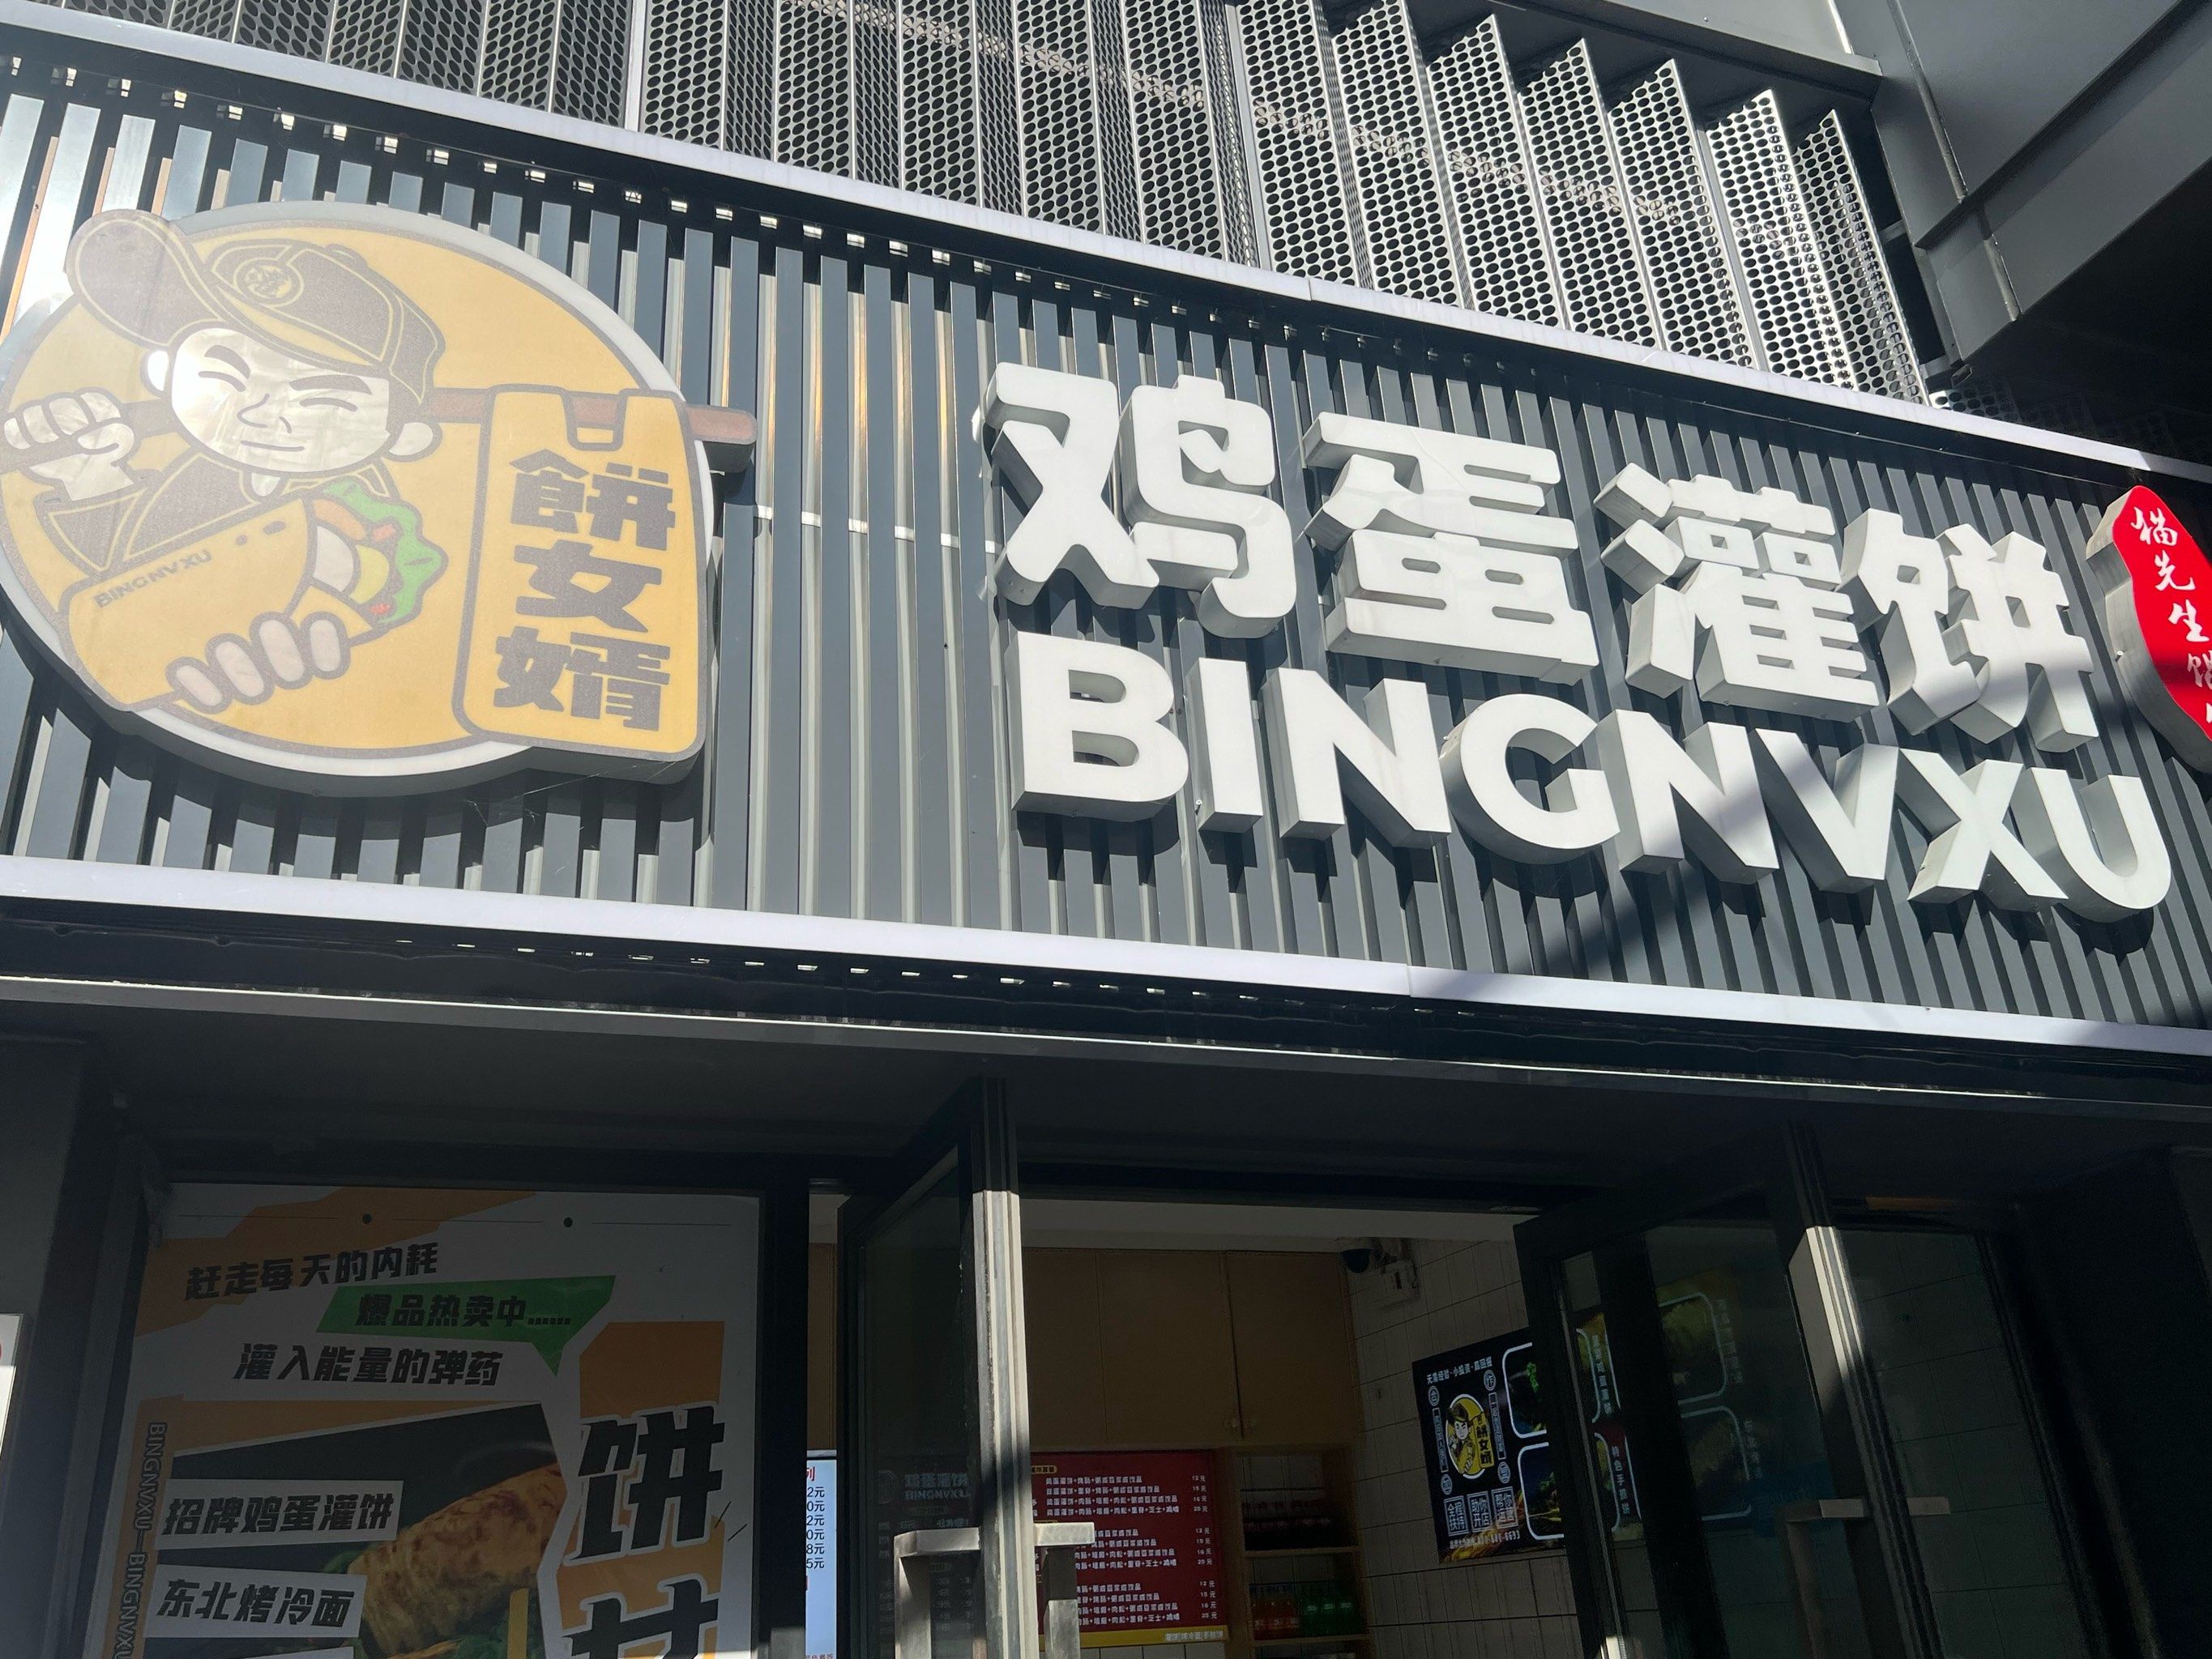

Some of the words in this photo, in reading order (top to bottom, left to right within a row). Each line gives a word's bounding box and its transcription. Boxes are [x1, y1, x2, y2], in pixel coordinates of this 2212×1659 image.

[93, 548, 214, 609] BINGNVXU
[987, 362, 2099, 744] 鸡蛋灌饼
[2131, 506, 2212, 725] 猫先生
[1013, 632, 2171, 914] BINGNVXU
[185, 1242, 438, 1301] 赶走每天的内耗
[233, 1343, 504, 1386] 灌入能量的弹药
[162, 1493, 394, 1534] 招牌鸡蛋灌饼
[157, 1579, 354, 1627] 东北烤冷面
